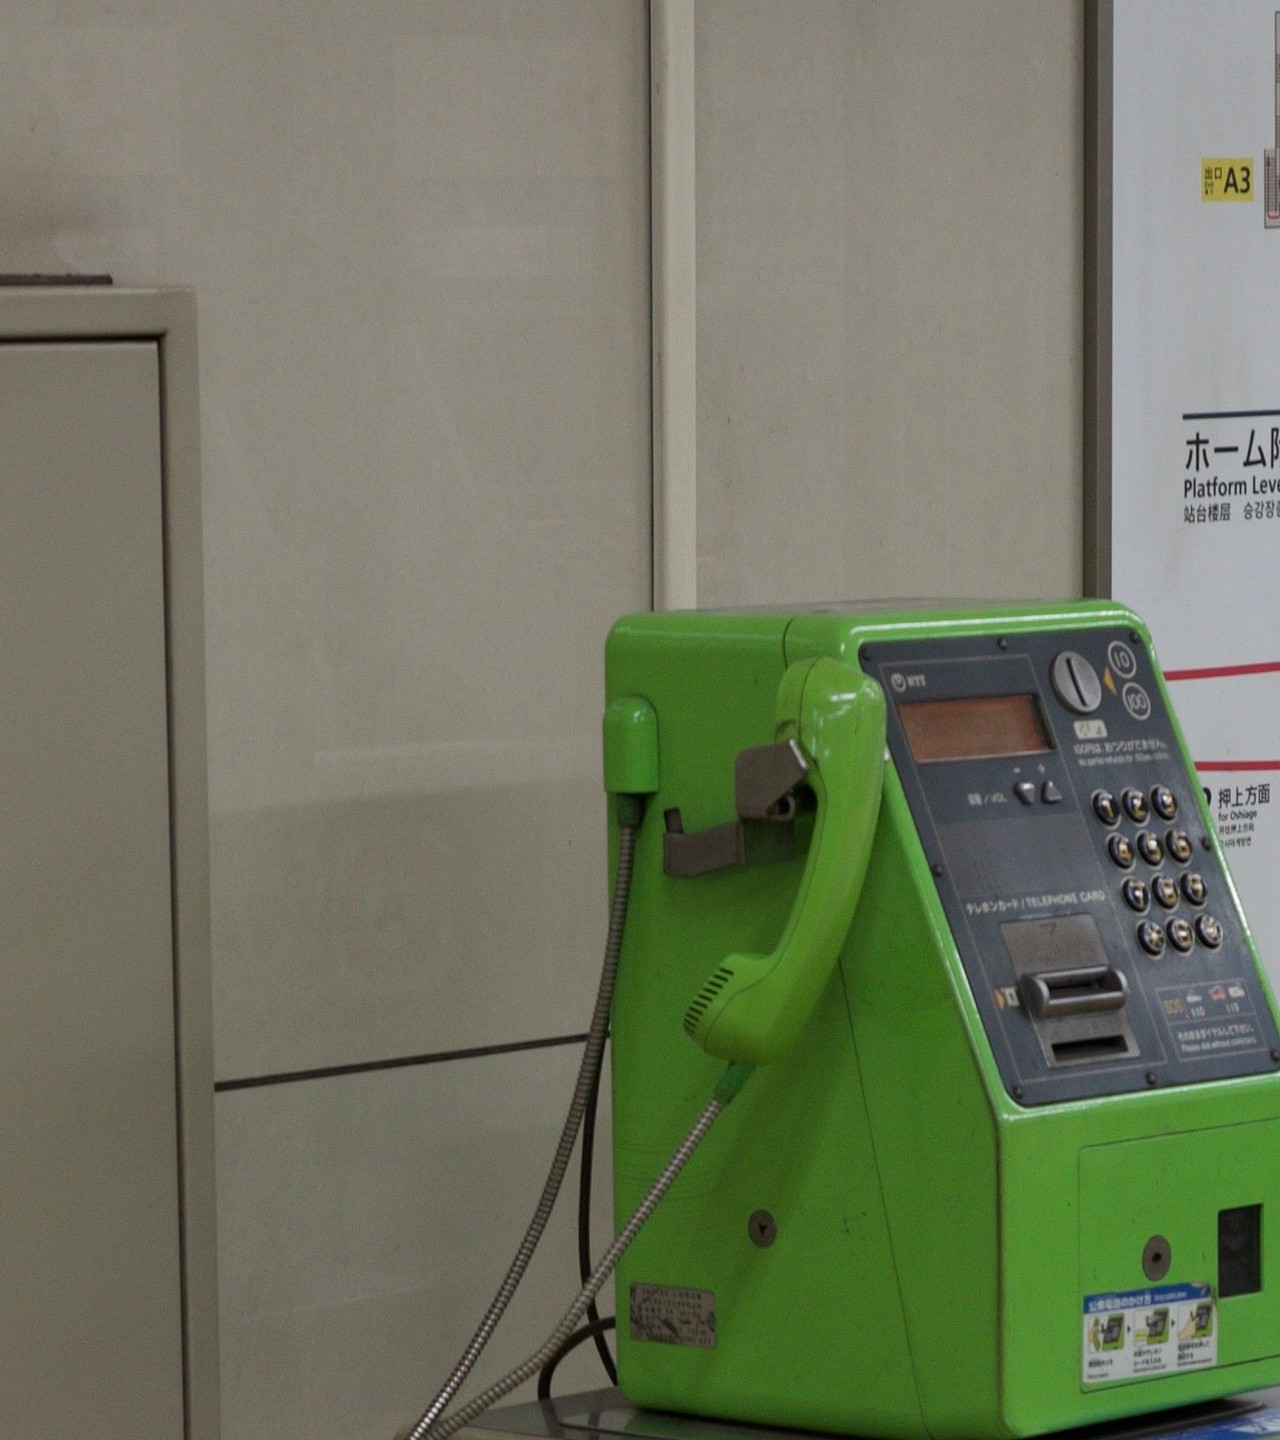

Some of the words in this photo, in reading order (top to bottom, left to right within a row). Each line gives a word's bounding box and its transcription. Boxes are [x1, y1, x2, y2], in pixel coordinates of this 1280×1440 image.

[1223, 166, 1251, 194] A3
[1183, 475, 1247, 499] Platform
[1114, 650, 1130, 668] 10
[907, 674, 926, 687] NTT
[1127, 692, 1147, 710] 100
[1218, 783, 1270, 810] 押上方面
[1229, 809, 1258, 822] Oshiage
[966, 898, 1019, 915] テレホンカード
[1026, 892, 1079, 908] TELEPHONE
[1079, 890, 1106, 903] CARD
